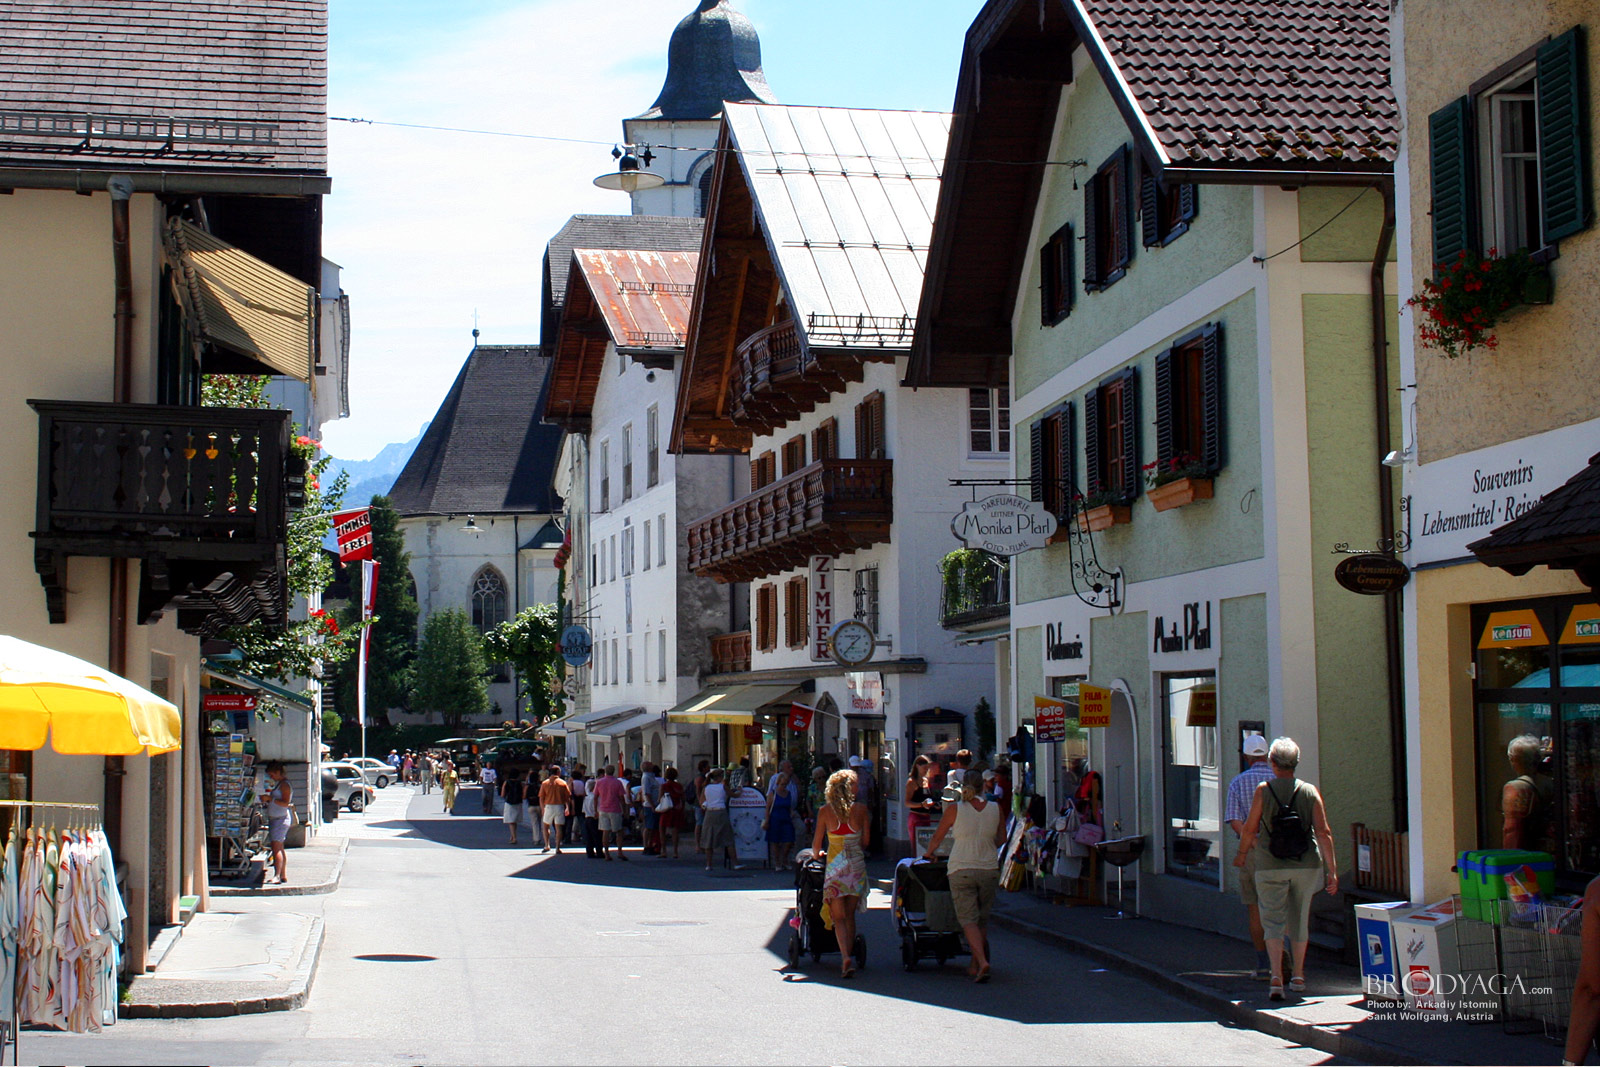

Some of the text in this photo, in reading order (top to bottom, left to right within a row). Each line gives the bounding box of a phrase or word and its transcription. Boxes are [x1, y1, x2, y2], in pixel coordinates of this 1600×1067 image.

[1473, 459, 1533, 494] Souvenirs
[981, 498, 1030, 512] PARFUMERIE
[1421, 492, 1545, 537] Lebensmittel Reise
[335, 513, 370, 537] ZIMMER
[963, 513, 1050, 535] Monika Pfarl
[343, 535, 368, 553] FREI
[982, 540, 1029, 553] FOTO FILME
[1346, 564, 1404, 574] Lebensmittel
[1357, 575, 1393, 588] Grocery
[815, 557, 831, 658] ZIMMER
[1492, 628, 1531, 639] KONSUM
[1084, 692, 1101, 701] FILM
[1036, 705, 1063, 717] FOTO
[1084, 704, 1102, 712] FOTO
[1080, 716, 1109, 725] SERVICE
